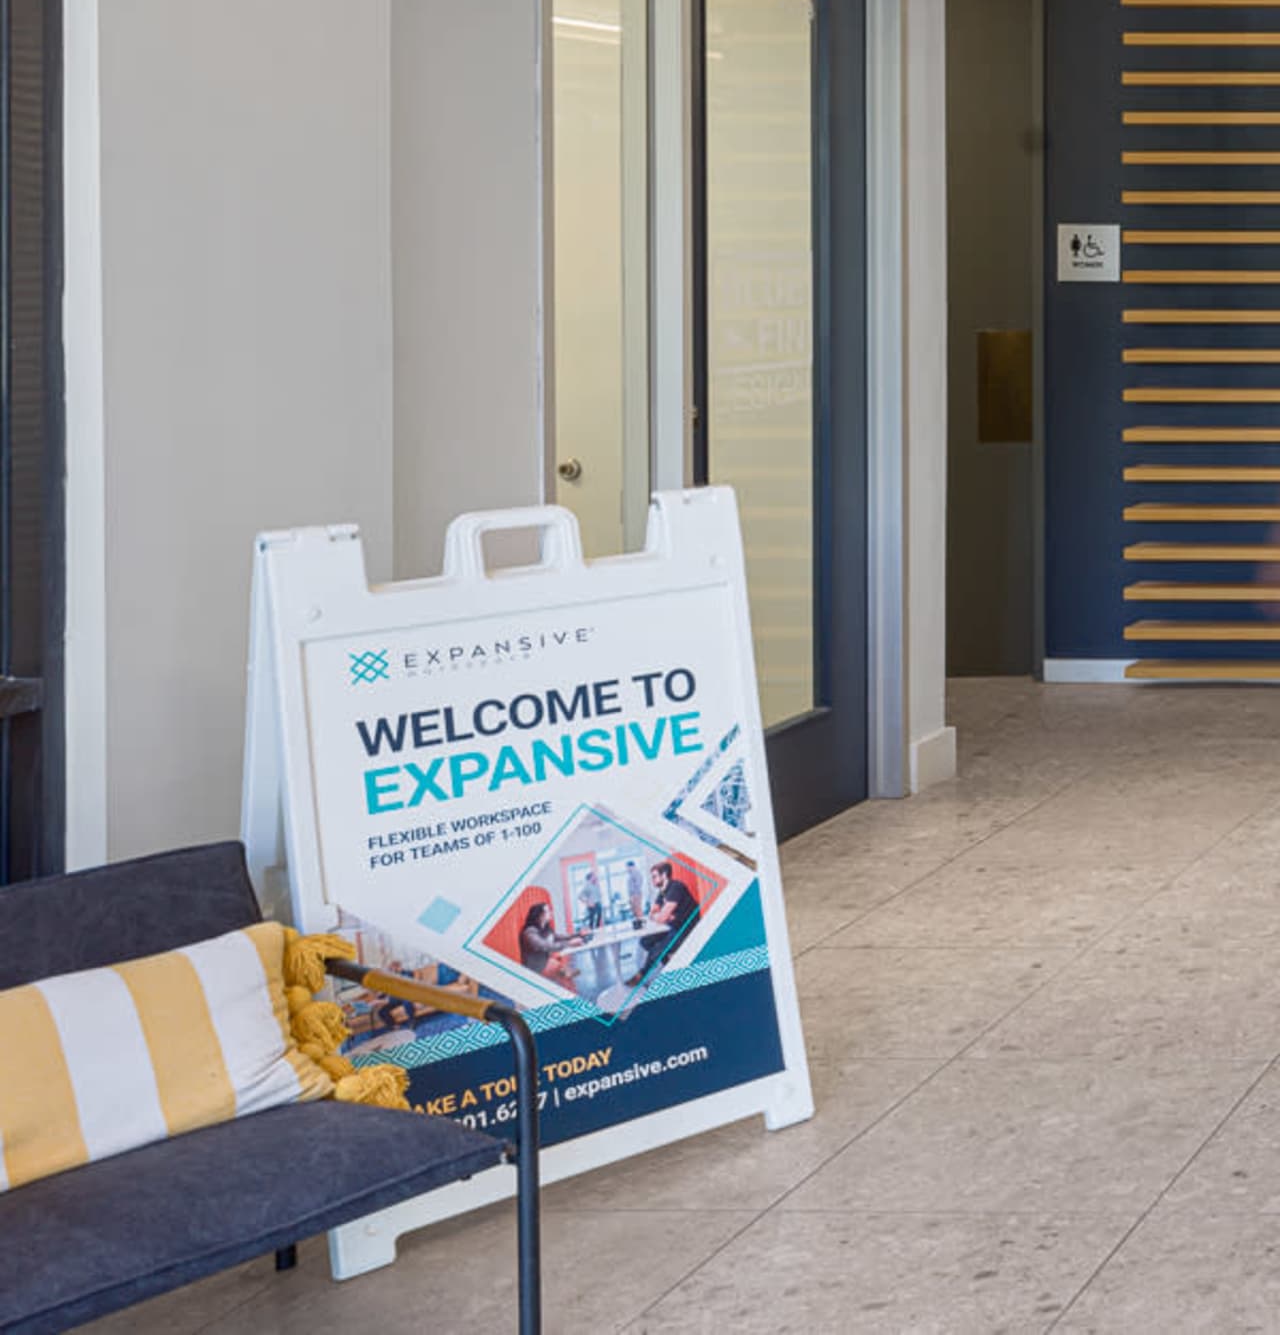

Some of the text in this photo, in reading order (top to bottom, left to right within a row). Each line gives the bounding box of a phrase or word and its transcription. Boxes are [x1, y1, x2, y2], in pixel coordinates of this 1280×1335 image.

[403, 627, 588, 669] EXPANSIVE
[356, 667, 697, 757] WELCOME TO
[363, 711, 704, 816] EXPANSIVE
[368, 800, 553, 850] FLEXIBLE WORKSPACE
[369, 821, 543, 870] FOR TEAMS OF 1-100
[412, 1093, 459, 1117] AKE
[460, 1089, 478, 1109] A
[543, 1046, 613, 1082] TODAY
[564, 1045, 708, 1102] expansive.com
